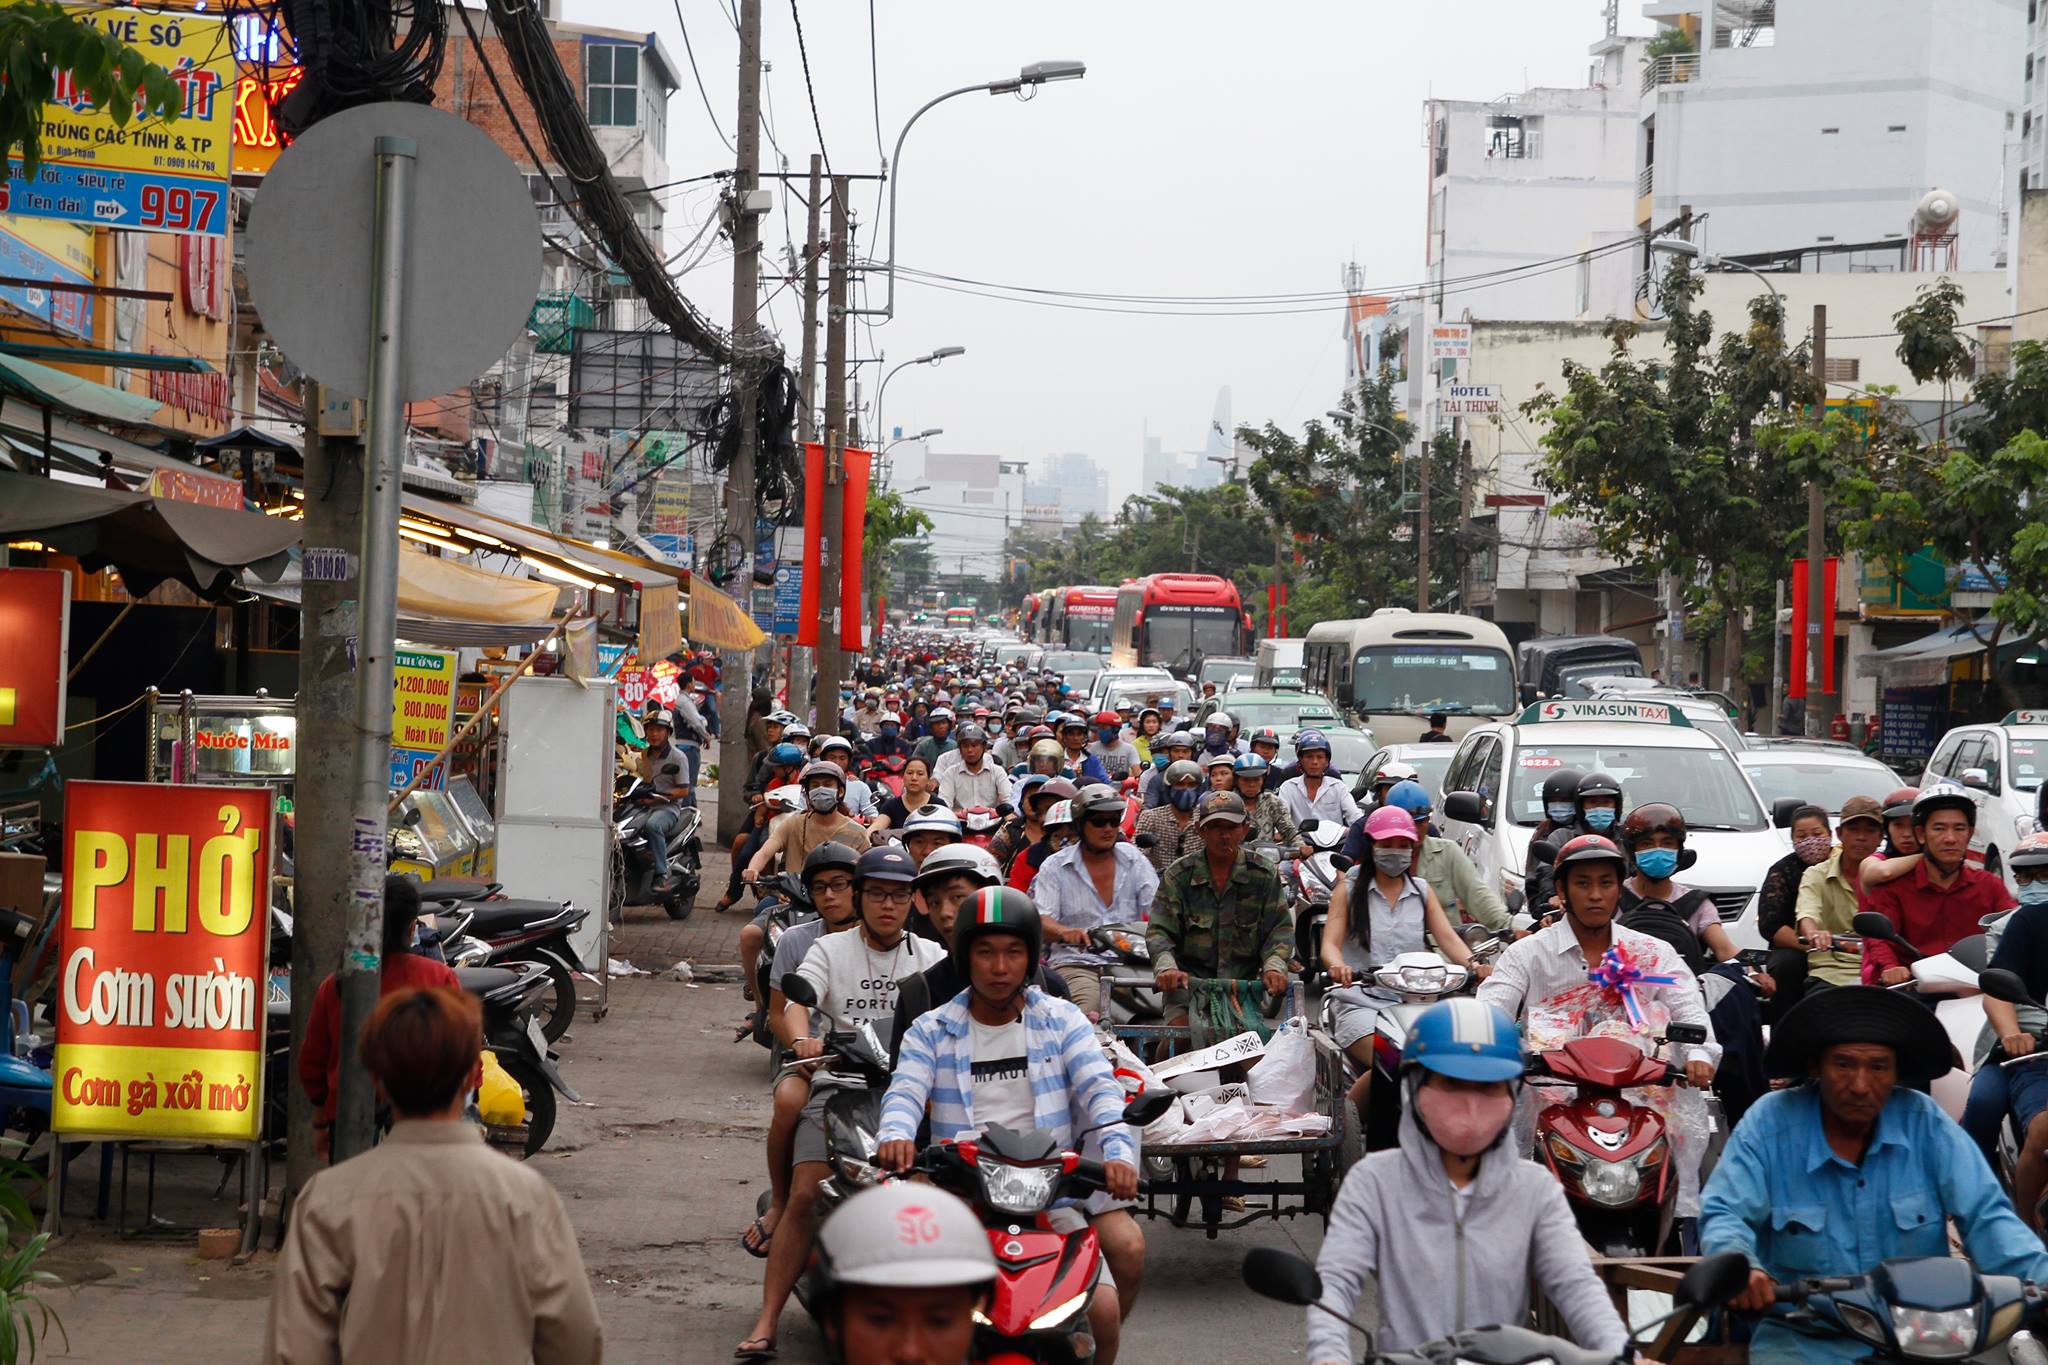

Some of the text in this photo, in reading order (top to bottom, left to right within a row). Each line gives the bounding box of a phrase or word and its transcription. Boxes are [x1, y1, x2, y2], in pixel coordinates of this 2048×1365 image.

[150, 18, 184, 47] SỐ
[94, 126, 126, 145] CÁC
[174, 136, 186, 150] &
[191, 137, 212, 153] TP
[140, 185, 218, 232] 997
[1450, 386, 1491, 397] HOTEL
[400, 676, 449, 696] 1.200.000đ
[404, 701, 447, 720] 800.000đ
[1572, 704, 1668, 719] VINASUN TAXI
[195, 730, 248, 749] Nước
[70, 804, 260, 936] PHỞ
[63, 946, 255, 1031] Cơm sườn
[860, 979, 896, 992] GOO
[846, 998, 897, 1011] FORTU
[62, 1067, 121, 1107] Cơm
[127, 1072, 157, 1116] gà
